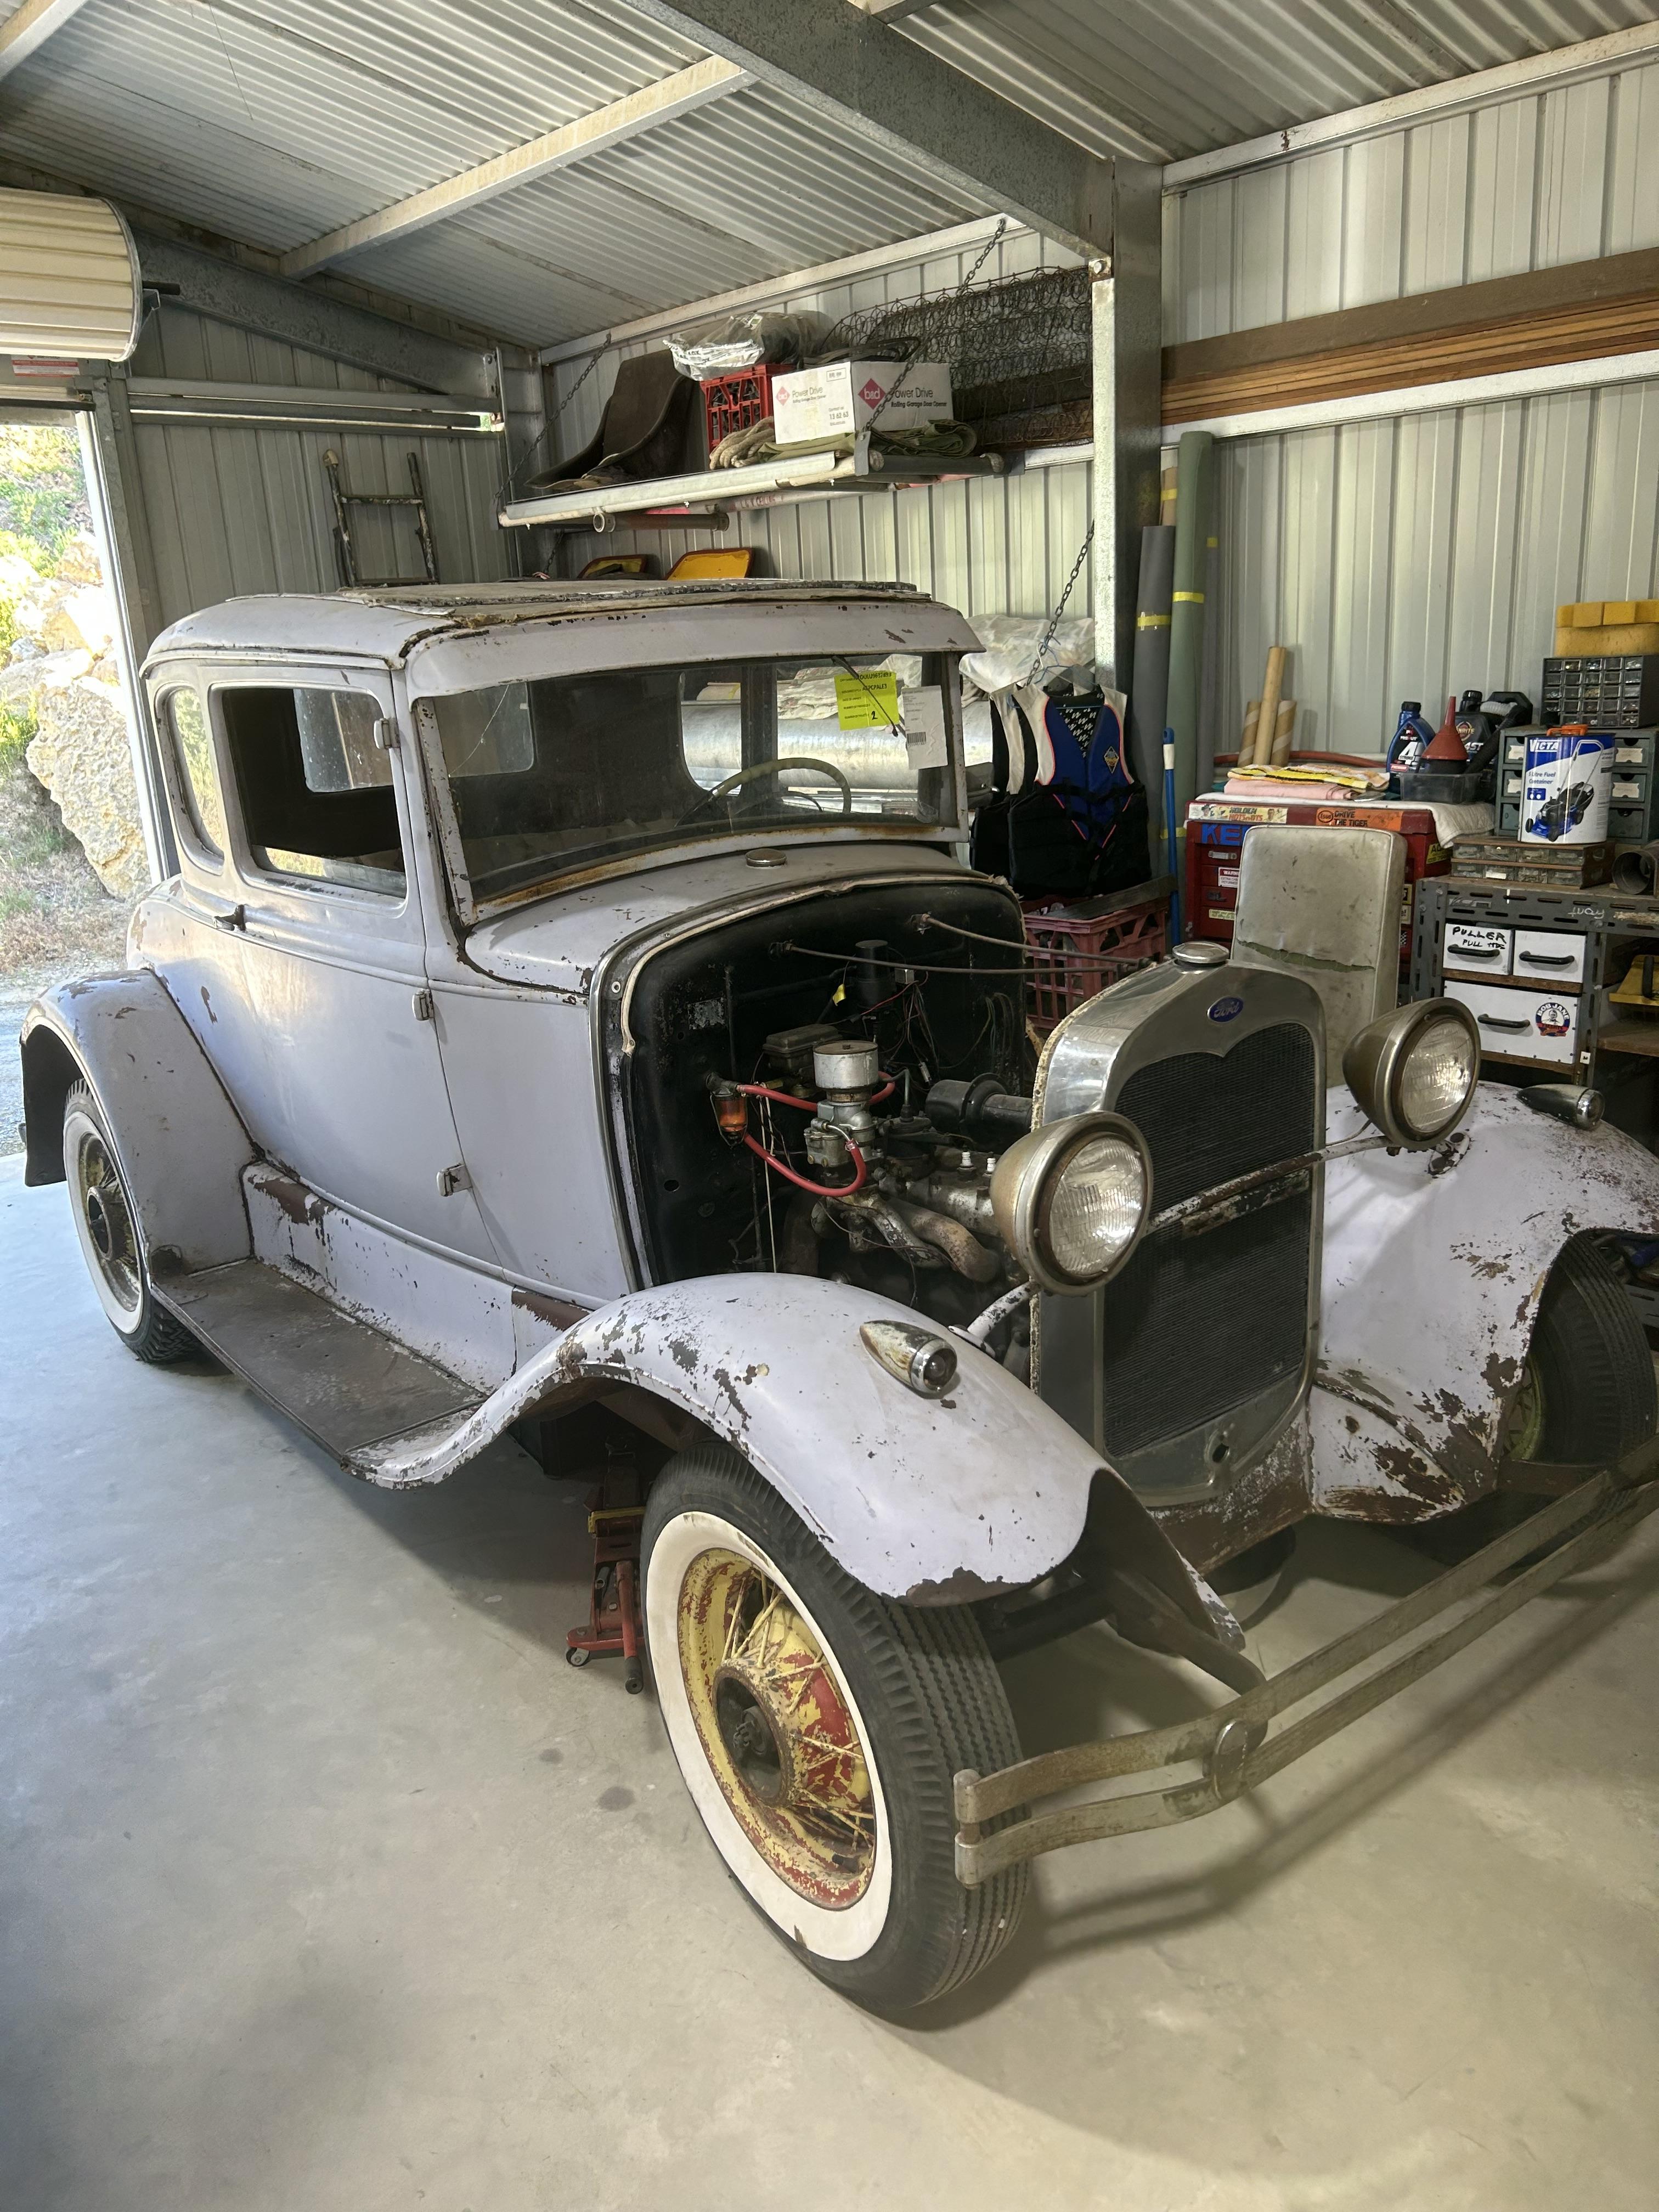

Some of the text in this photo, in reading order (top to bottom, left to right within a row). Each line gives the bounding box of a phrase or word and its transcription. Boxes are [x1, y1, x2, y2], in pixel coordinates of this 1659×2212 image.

[792, 386, 823, 398] Power Drive
[894, 387, 933, 398] ower Drive
[1530, 739, 1559, 752] VICTA
[1398, 741, 1418, 765] 4
[1334, 818, 1368, 827] THE TIGER
[1453, 926, 1506, 944] PULLER
[1214, 1001, 1240, 1018] Ford
[1537, 1003, 1570, 1019] BOB JANE
